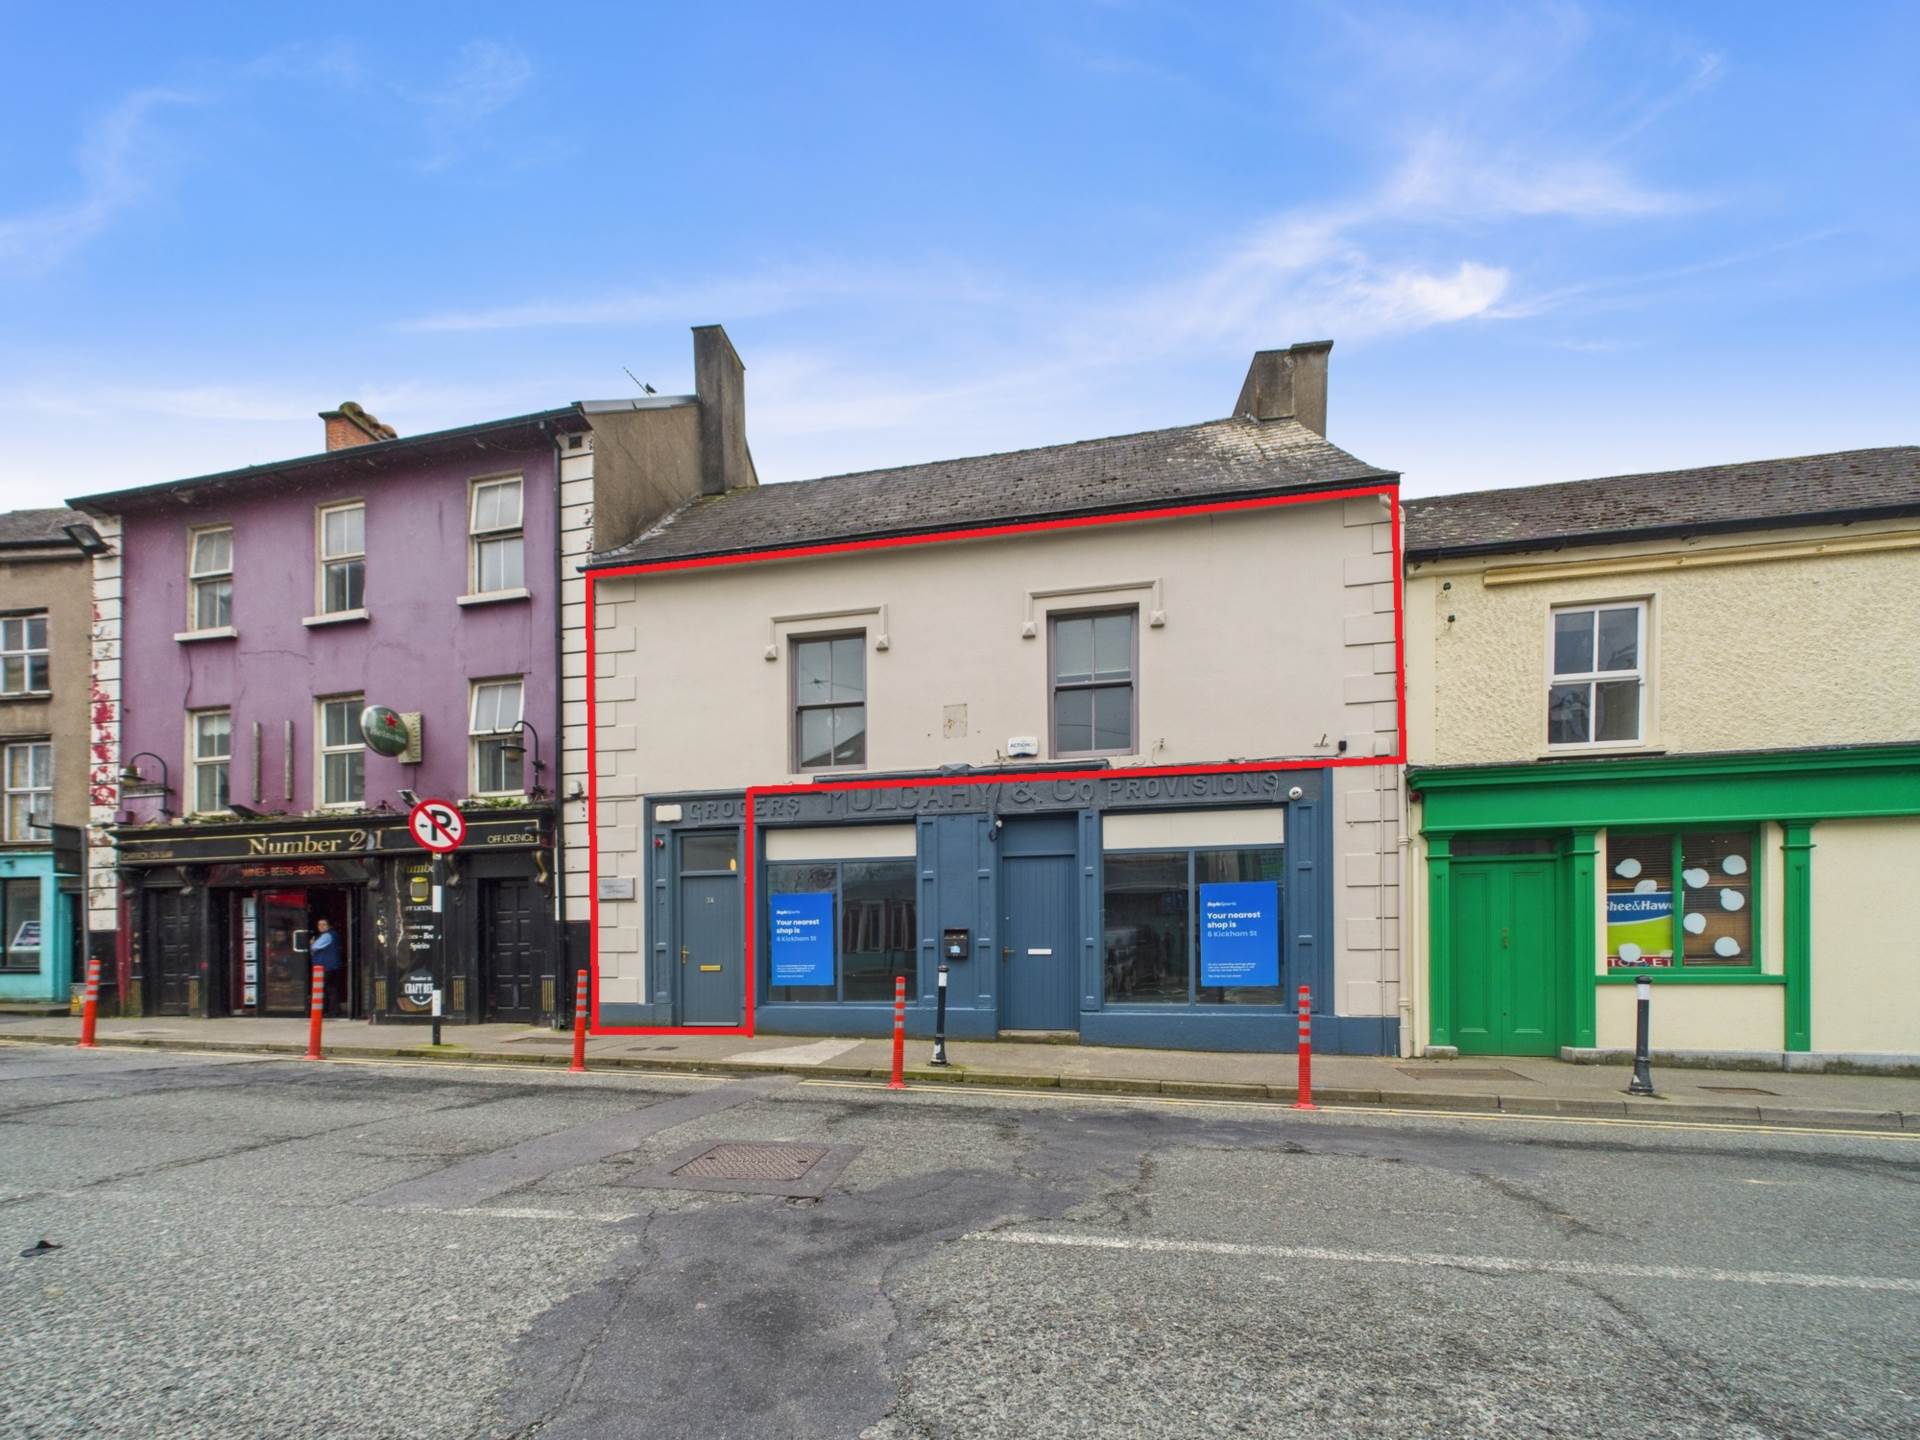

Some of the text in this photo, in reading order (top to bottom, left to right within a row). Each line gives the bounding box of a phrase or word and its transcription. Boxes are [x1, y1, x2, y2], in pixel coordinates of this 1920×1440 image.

[1108, 772, 1279, 800] PROVISIONS
[431, 809, 452, 841] P
[248, 835, 341, 855] Number
[1228, 911, 1261, 919] nearest
[793, 918, 820, 926] nearest
[1207, 920, 1237, 930] shop is
[776, 927, 793, 935] shop
[404, 983, 422, 994] CRAFT
